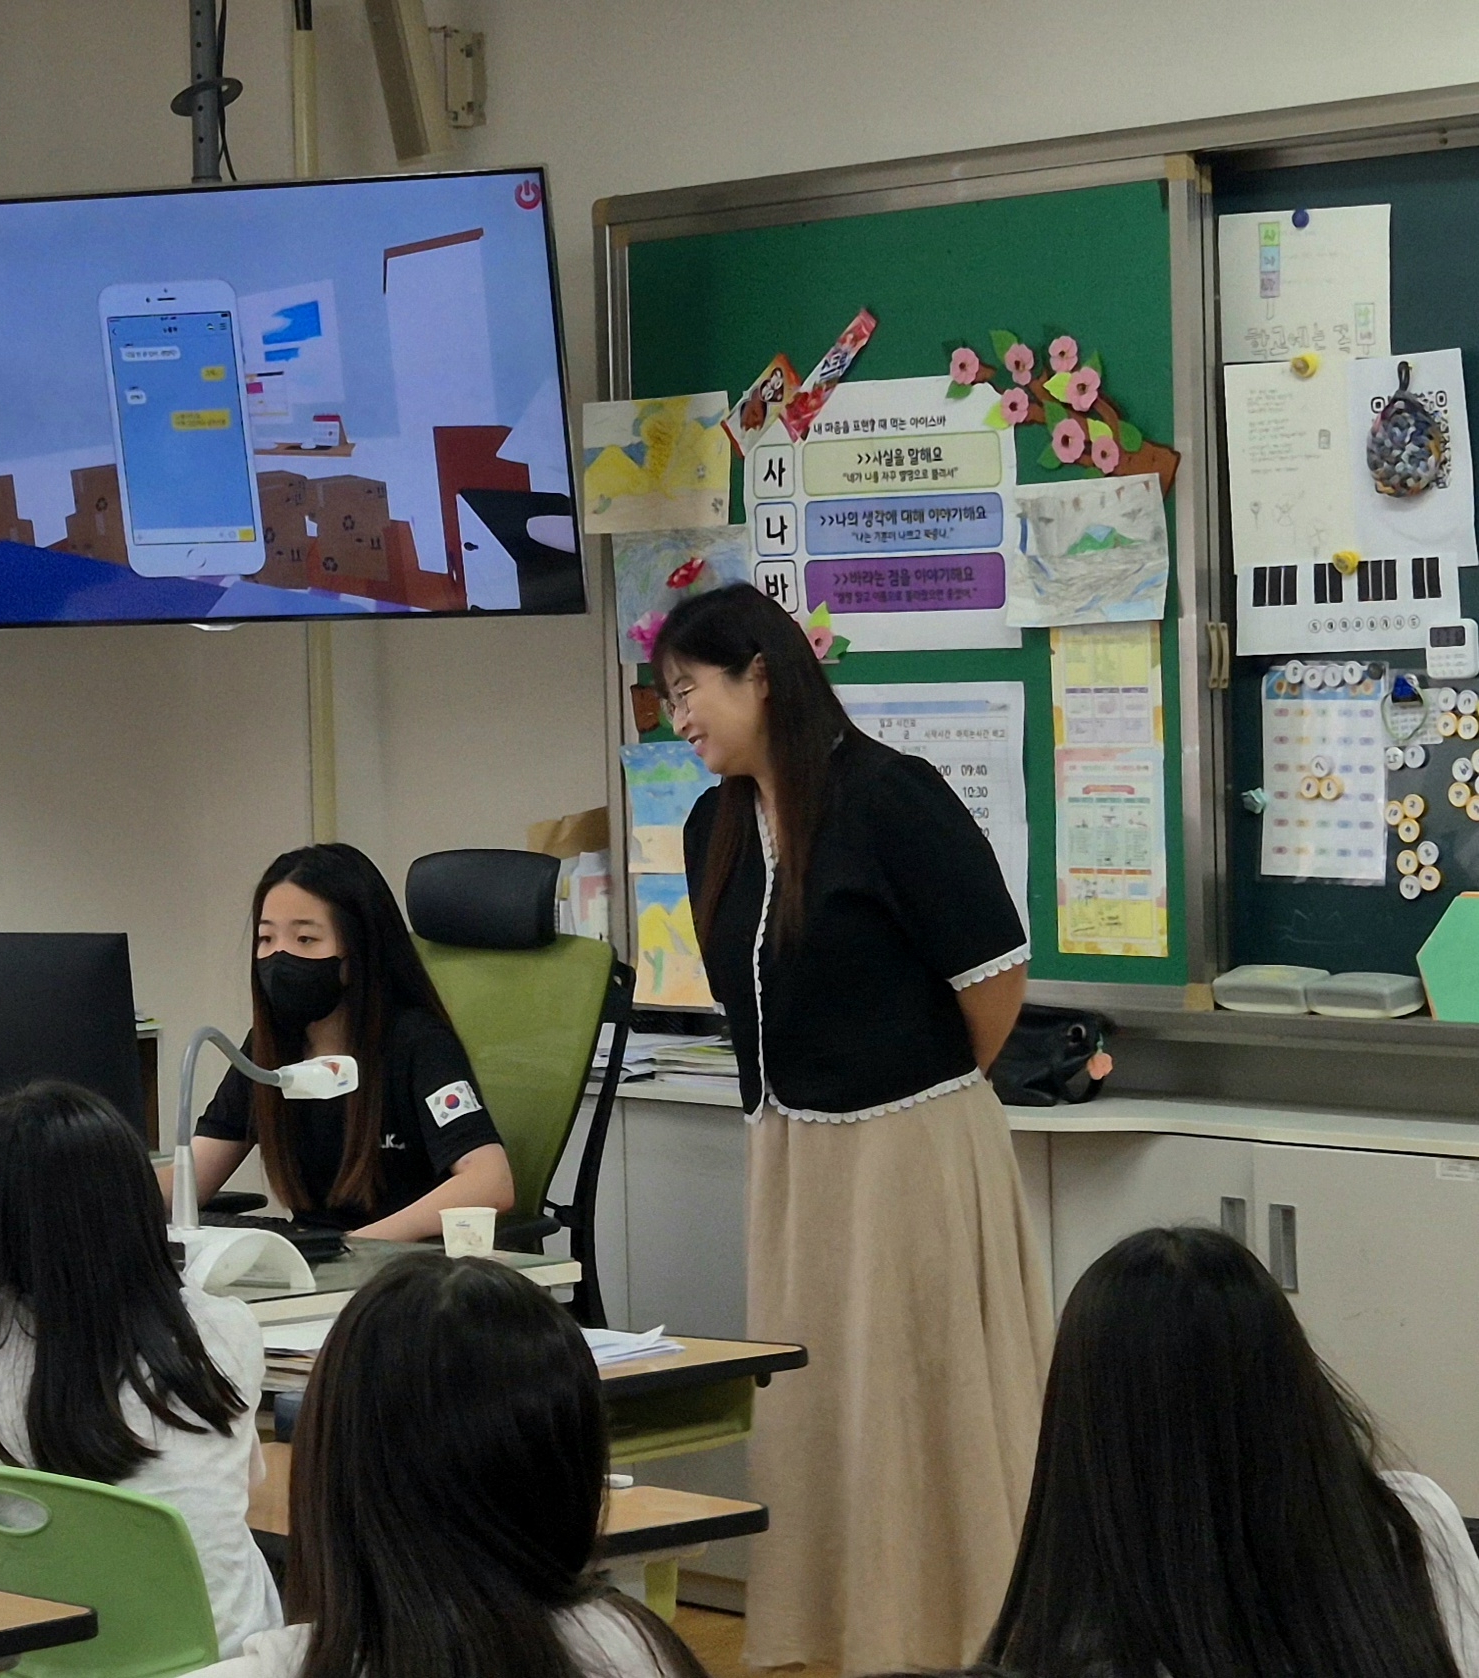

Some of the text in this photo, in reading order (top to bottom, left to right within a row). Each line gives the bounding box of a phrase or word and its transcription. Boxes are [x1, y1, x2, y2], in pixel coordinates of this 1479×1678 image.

[813, 415, 947, 435] 내 마음을 표현할 때 먹는 아이스바
[908, 446, 943, 465] 말해요
[763, 457, 787, 487] 사
[881, 470, 897, 482] 자꾸
[862, 509, 898, 527] 생각에
[900, 508, 925, 525] 대해
[928, 506, 988, 523] 이야기해요
[765, 515, 788, 545] 나
[874, 530, 897, 543] 기분이
[888, 568, 911, 587] 점을
[914, 566, 975, 583] 이야기해요
[764, 573, 789, 603] 바
[961, 764, 988, 777] 09:40
[963, 786, 989, 798] 10:30
